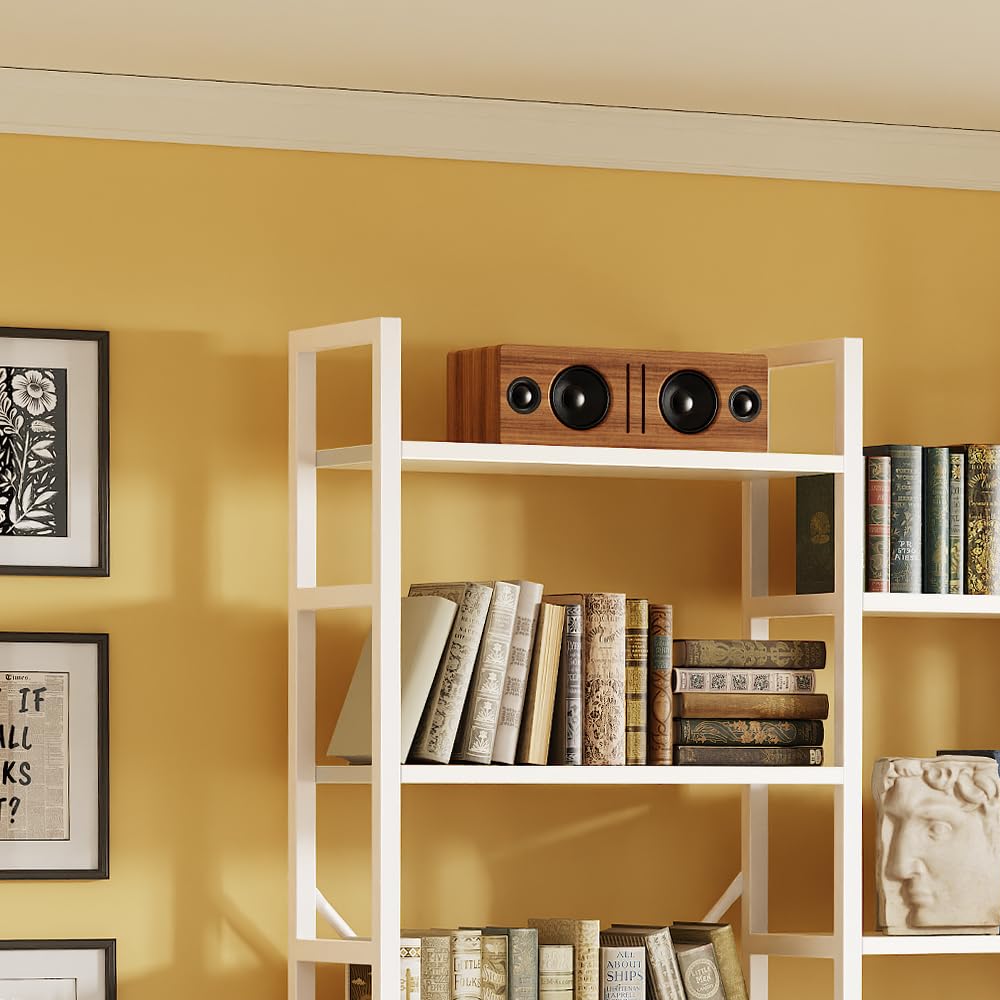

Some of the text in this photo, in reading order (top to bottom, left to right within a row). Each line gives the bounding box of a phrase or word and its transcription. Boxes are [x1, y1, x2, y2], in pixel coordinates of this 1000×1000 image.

[19, 686, 47, 713] IF
[616, 950, 636, 959] ALL
[606, 960, 642, 969] ABOUT
[605, 970, 644, 983] SHIPS
